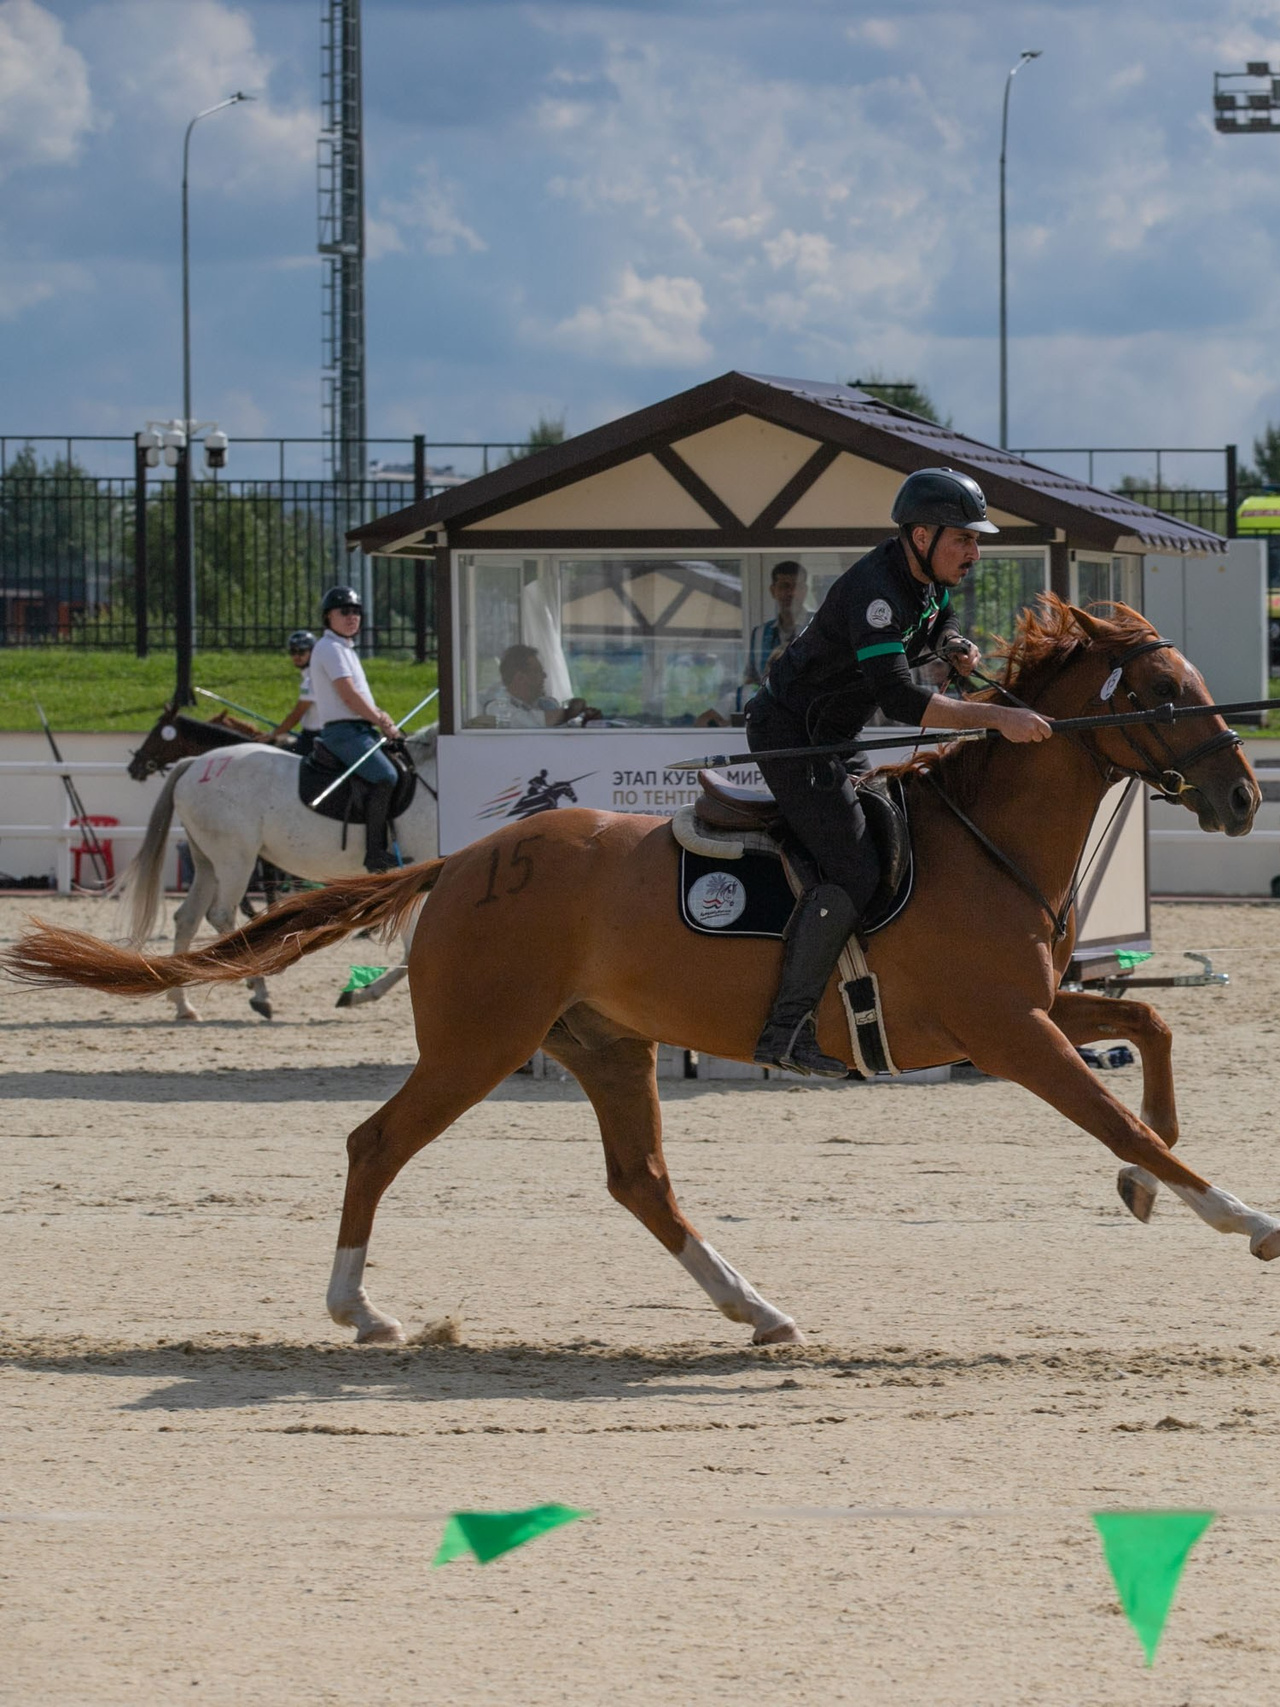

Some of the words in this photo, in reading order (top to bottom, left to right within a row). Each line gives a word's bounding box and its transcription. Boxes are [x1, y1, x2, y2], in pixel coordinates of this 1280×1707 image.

[197, 756, 233, 784] 17
[612, 770, 656, 786] ЭТАП
[663, 770, 708, 786] КУБ
[726, 771, 767, 786] МИР
[612, 790, 638, 805] ПО
[474, 833, 546, 908] 15
